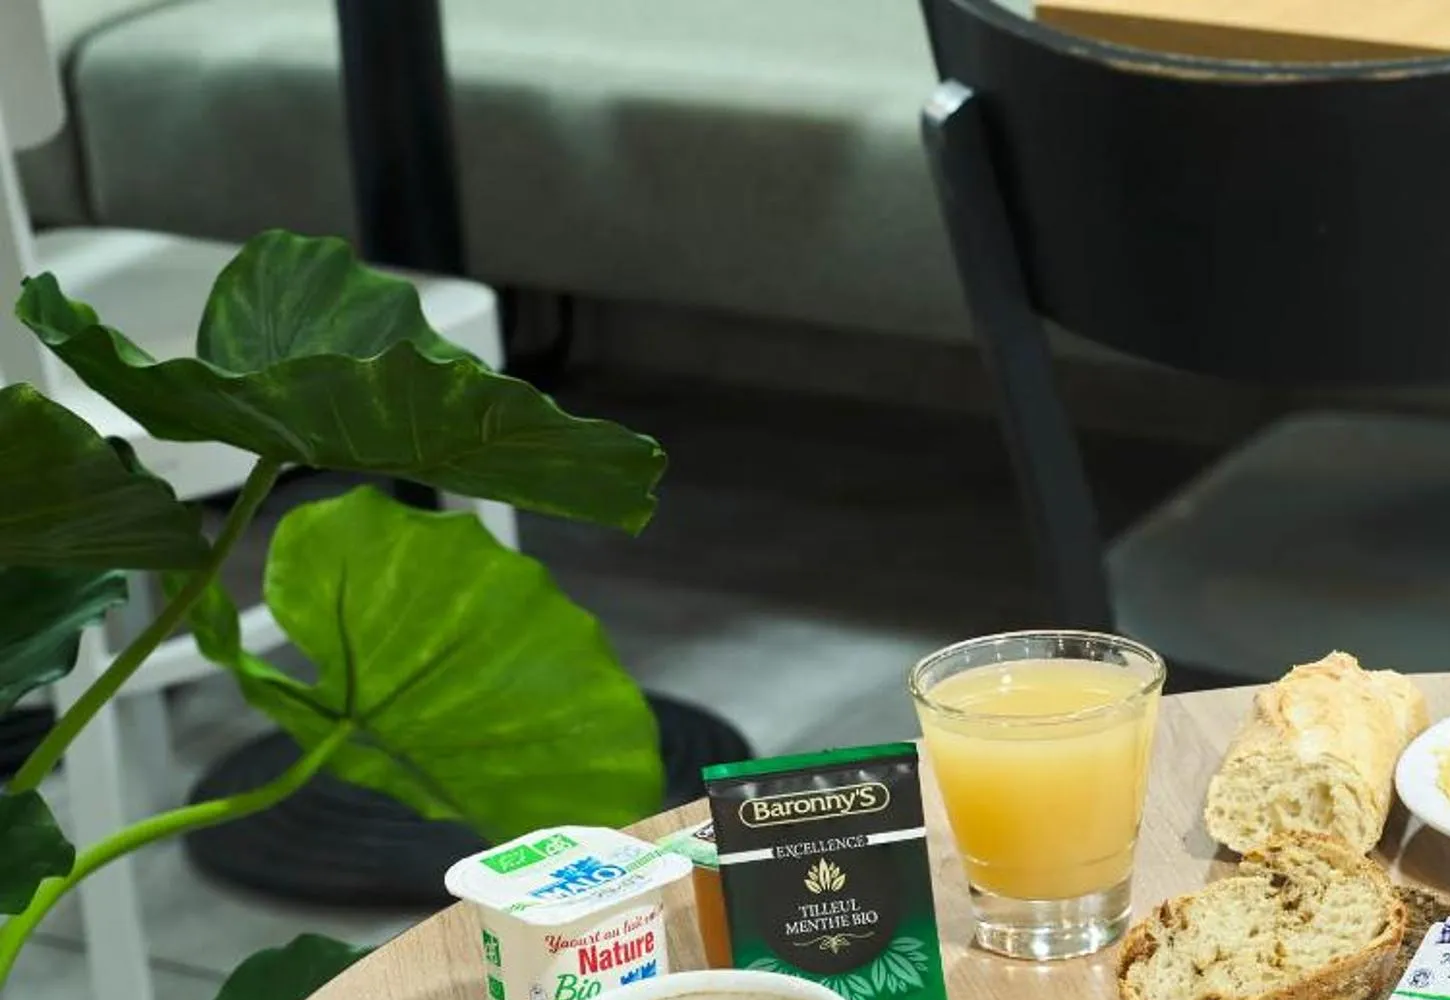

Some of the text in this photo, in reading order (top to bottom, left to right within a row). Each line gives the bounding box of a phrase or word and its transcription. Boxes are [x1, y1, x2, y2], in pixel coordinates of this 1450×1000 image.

[775, 835, 868, 859] EXCELLENCE
[798, 898, 861, 918] TILLEUL
[785, 909, 879, 936] MENTHE BIO
[544, 932, 600, 954] Yaourt
[577, 930, 655, 976] Nature
